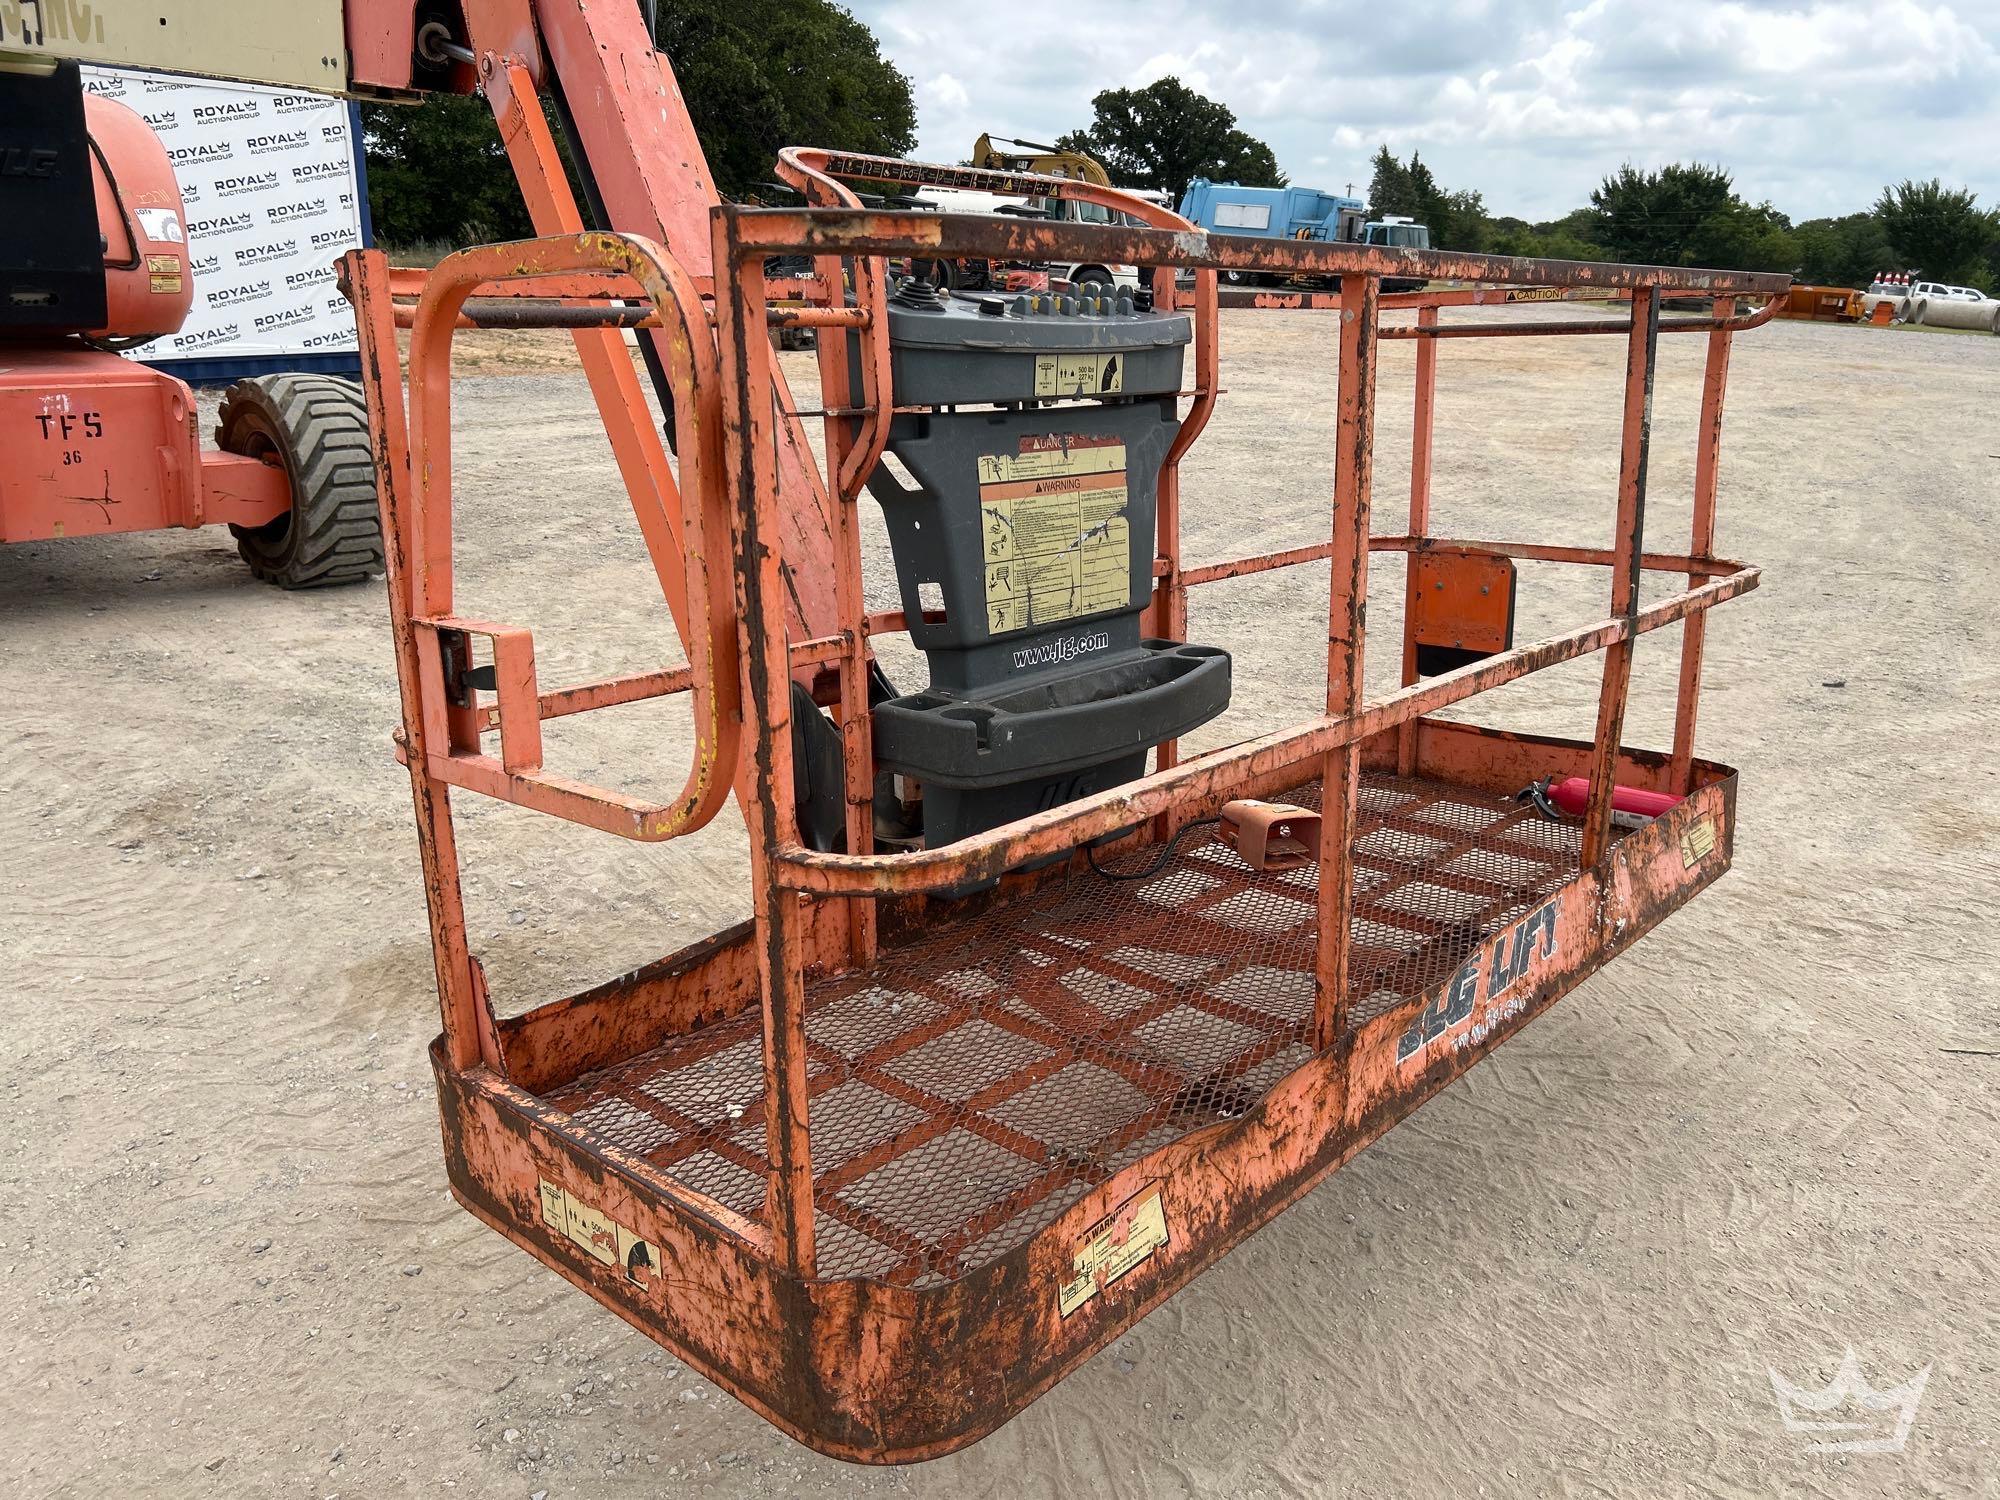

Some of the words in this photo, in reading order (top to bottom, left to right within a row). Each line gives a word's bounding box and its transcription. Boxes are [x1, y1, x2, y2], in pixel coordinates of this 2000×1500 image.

[193, 103, 245, 118] ROYAL
[277, 105, 309, 114] AUCTION
[310, 102, 335, 110] GROUP
[197, 115, 233, 125] AUCTION
[233, 112, 261, 121] GROUP
[247, 132, 295, 148] ROYAL
[250, 145, 284, 155] AUCTION
[284, 141, 310, 150] GROUP
[171, 157, 204, 168] UCTION
[206, 153, 233, 162] GROUP
[1016, 160, 1029, 169] CAT
[292, 162, 338, 177] ROYAL
[214, 174, 265, 190] ROYAL
[295, 174, 327, 184] AUCTION
[218, 187, 253, 197] AUCTION
[254, 182, 280, 192] GROUP
[267, 201, 315, 218] ROYAL
[270, 215, 303, 225] AUCTION
[303, 208, 328, 218] GROUP
[187, 216, 239, 233] ROYAL
[190, 229, 226, 240] AUCTION
[227, 223, 254, 233] GROUP
[311, 228, 356, 244] ROYAL
[235, 242, 285, 260] ROYAL
[314, 240, 344, 250] AUCTION
[238, 256, 273, 267] AUCTION
[273, 250, 299, 260] GROUP
[193, 266, 221, 277] GROUP
[285, 267, 332, 284] ROYAL
[207, 284, 258, 302] ROYAL
[289, 281, 320, 291] AUCTION
[211, 298, 245, 310] AUCTION
[246, 290, 273, 301] GROUP
[1516, 289, 1560, 300] CAUTION
[254, 308, 302, 327] ROYAL
[258, 322, 290, 334] AUCTION
[291, 314, 316, 325] GROUP
[174, 328, 226, 348] ROYAL
[213, 333, 241, 345] GROUP
[303, 330, 348, 348] ROYAL
[1088, 373, 1094, 381] kg
[63, 450, 82, 466] 36
[1042, 478, 1081, 493] WARNING
[1013, 632, 1109, 669] www.jlg.com
